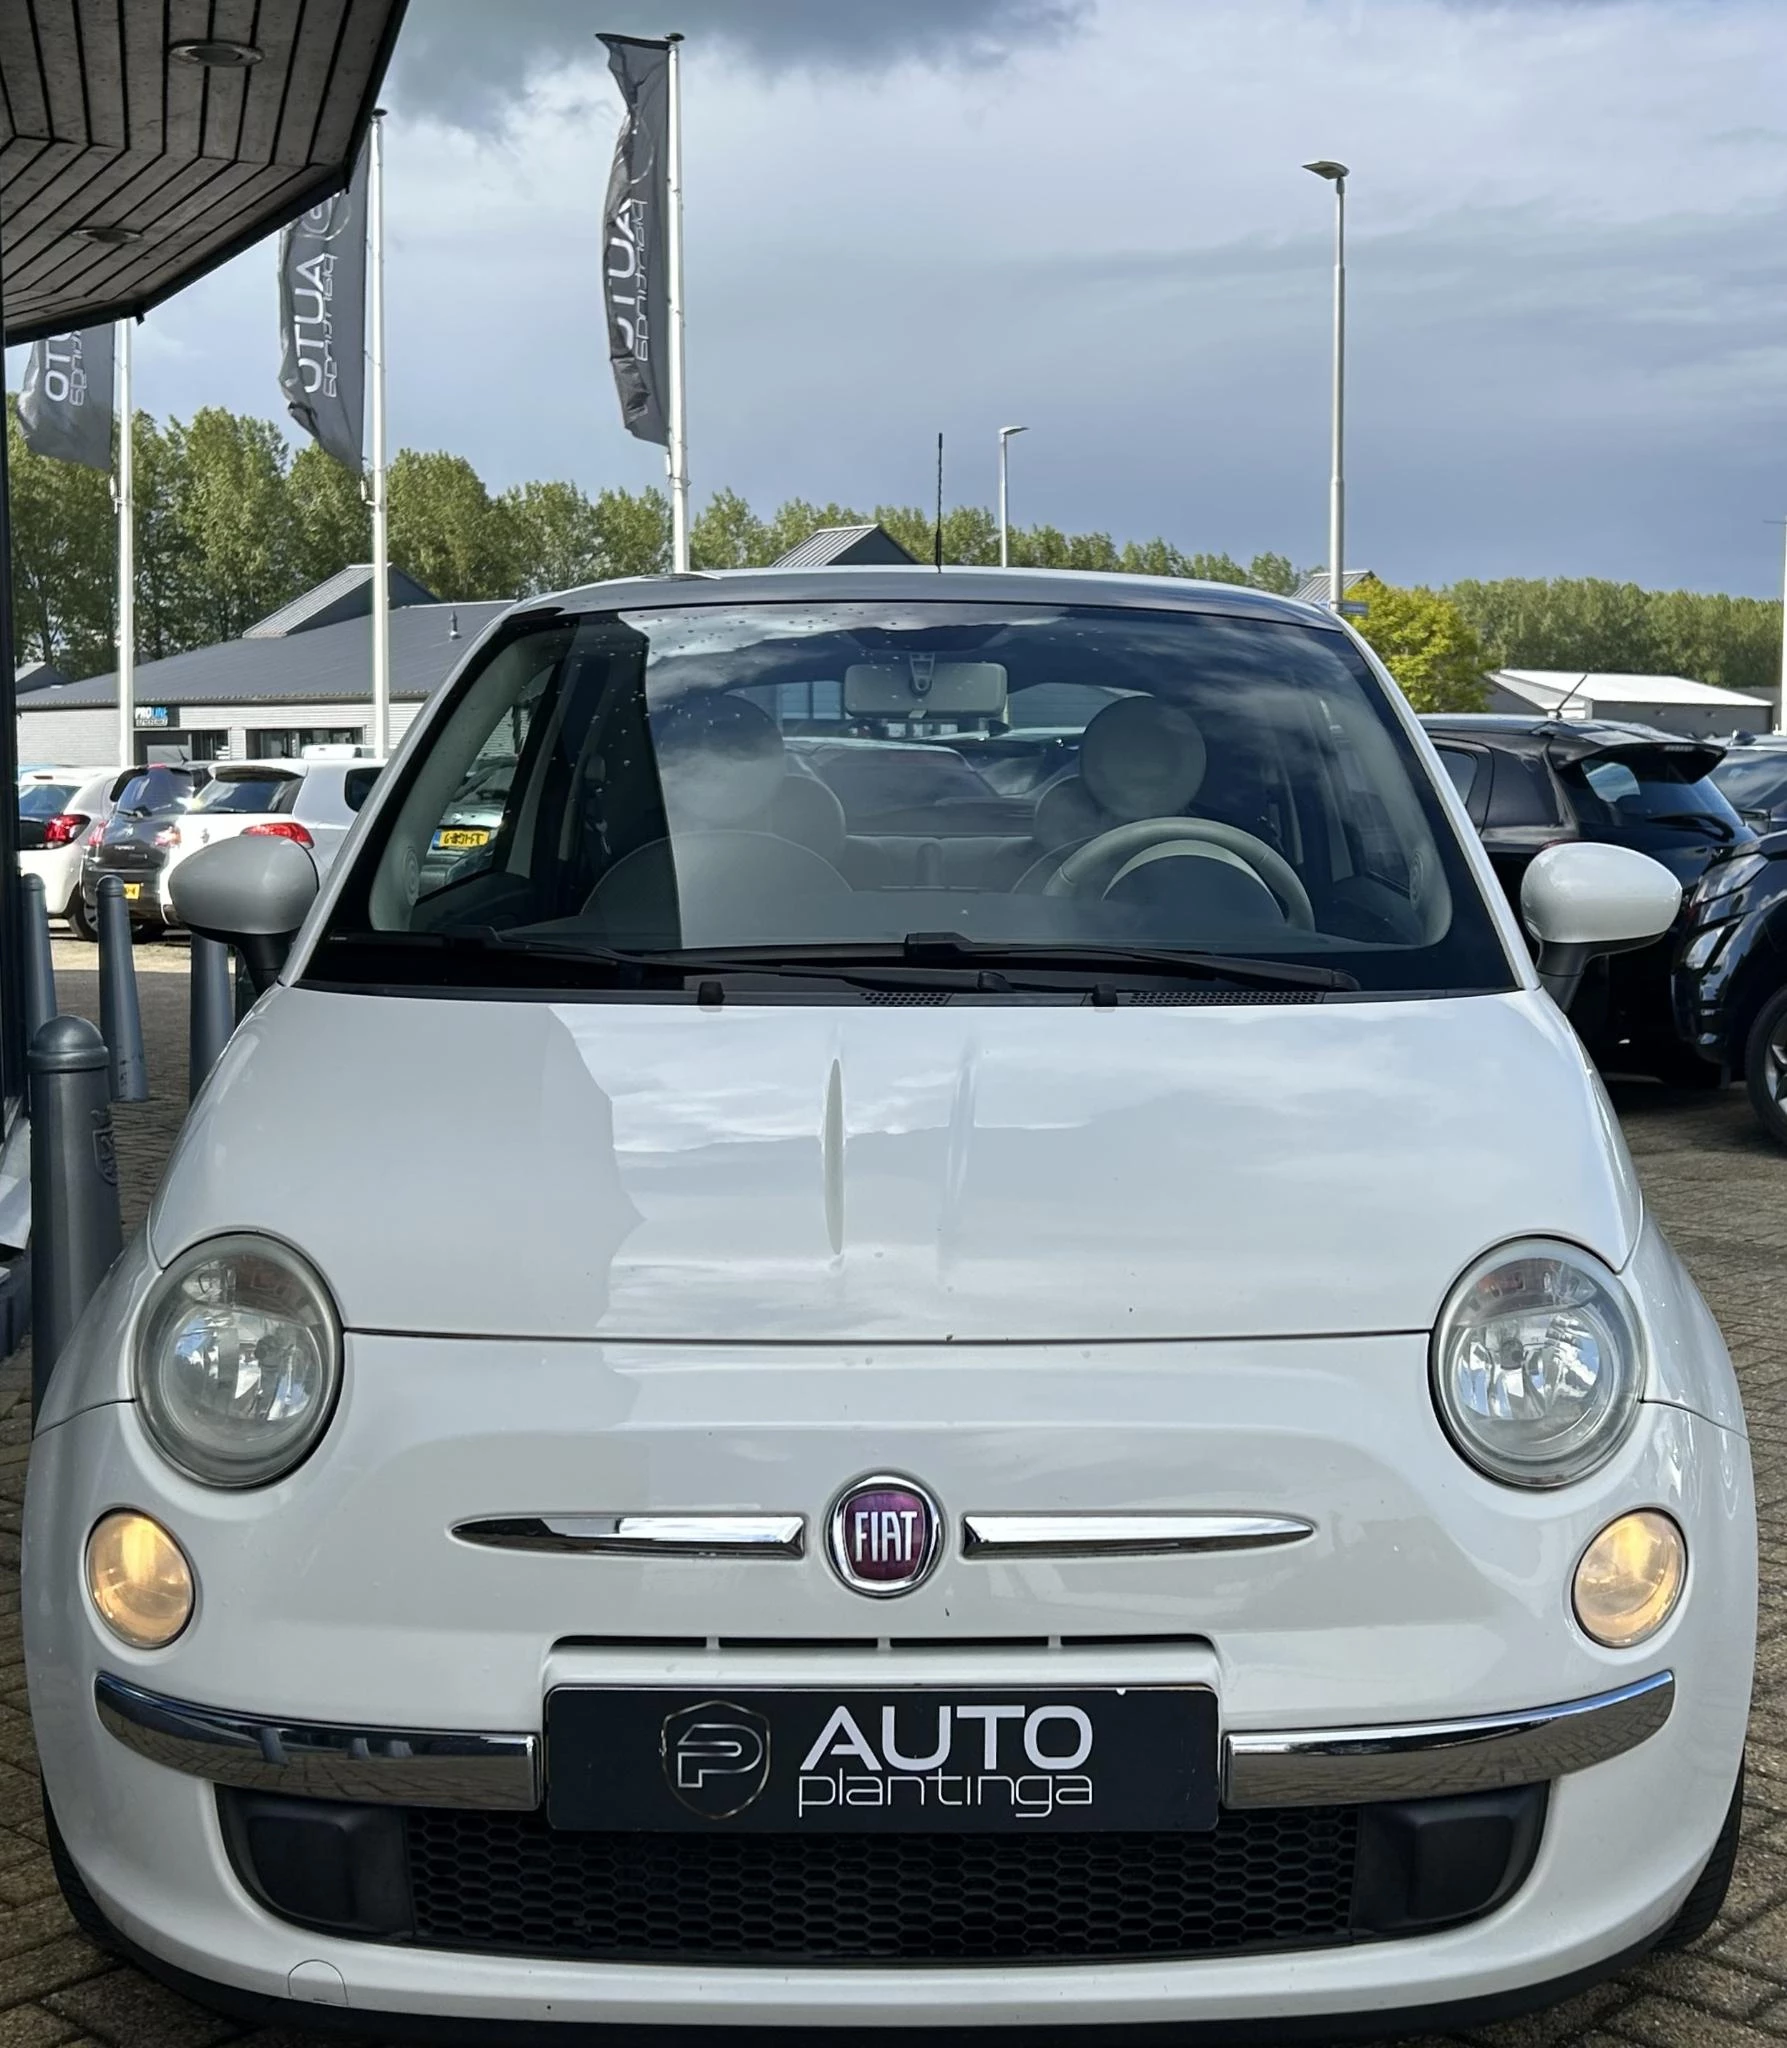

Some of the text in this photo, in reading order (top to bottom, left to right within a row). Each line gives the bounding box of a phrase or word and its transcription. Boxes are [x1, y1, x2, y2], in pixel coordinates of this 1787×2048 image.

[853, 1509, 919, 1562] FIAT
[799, 1704, 1094, 1770] AUTO
[798, 1768, 1093, 1818] plantinga
